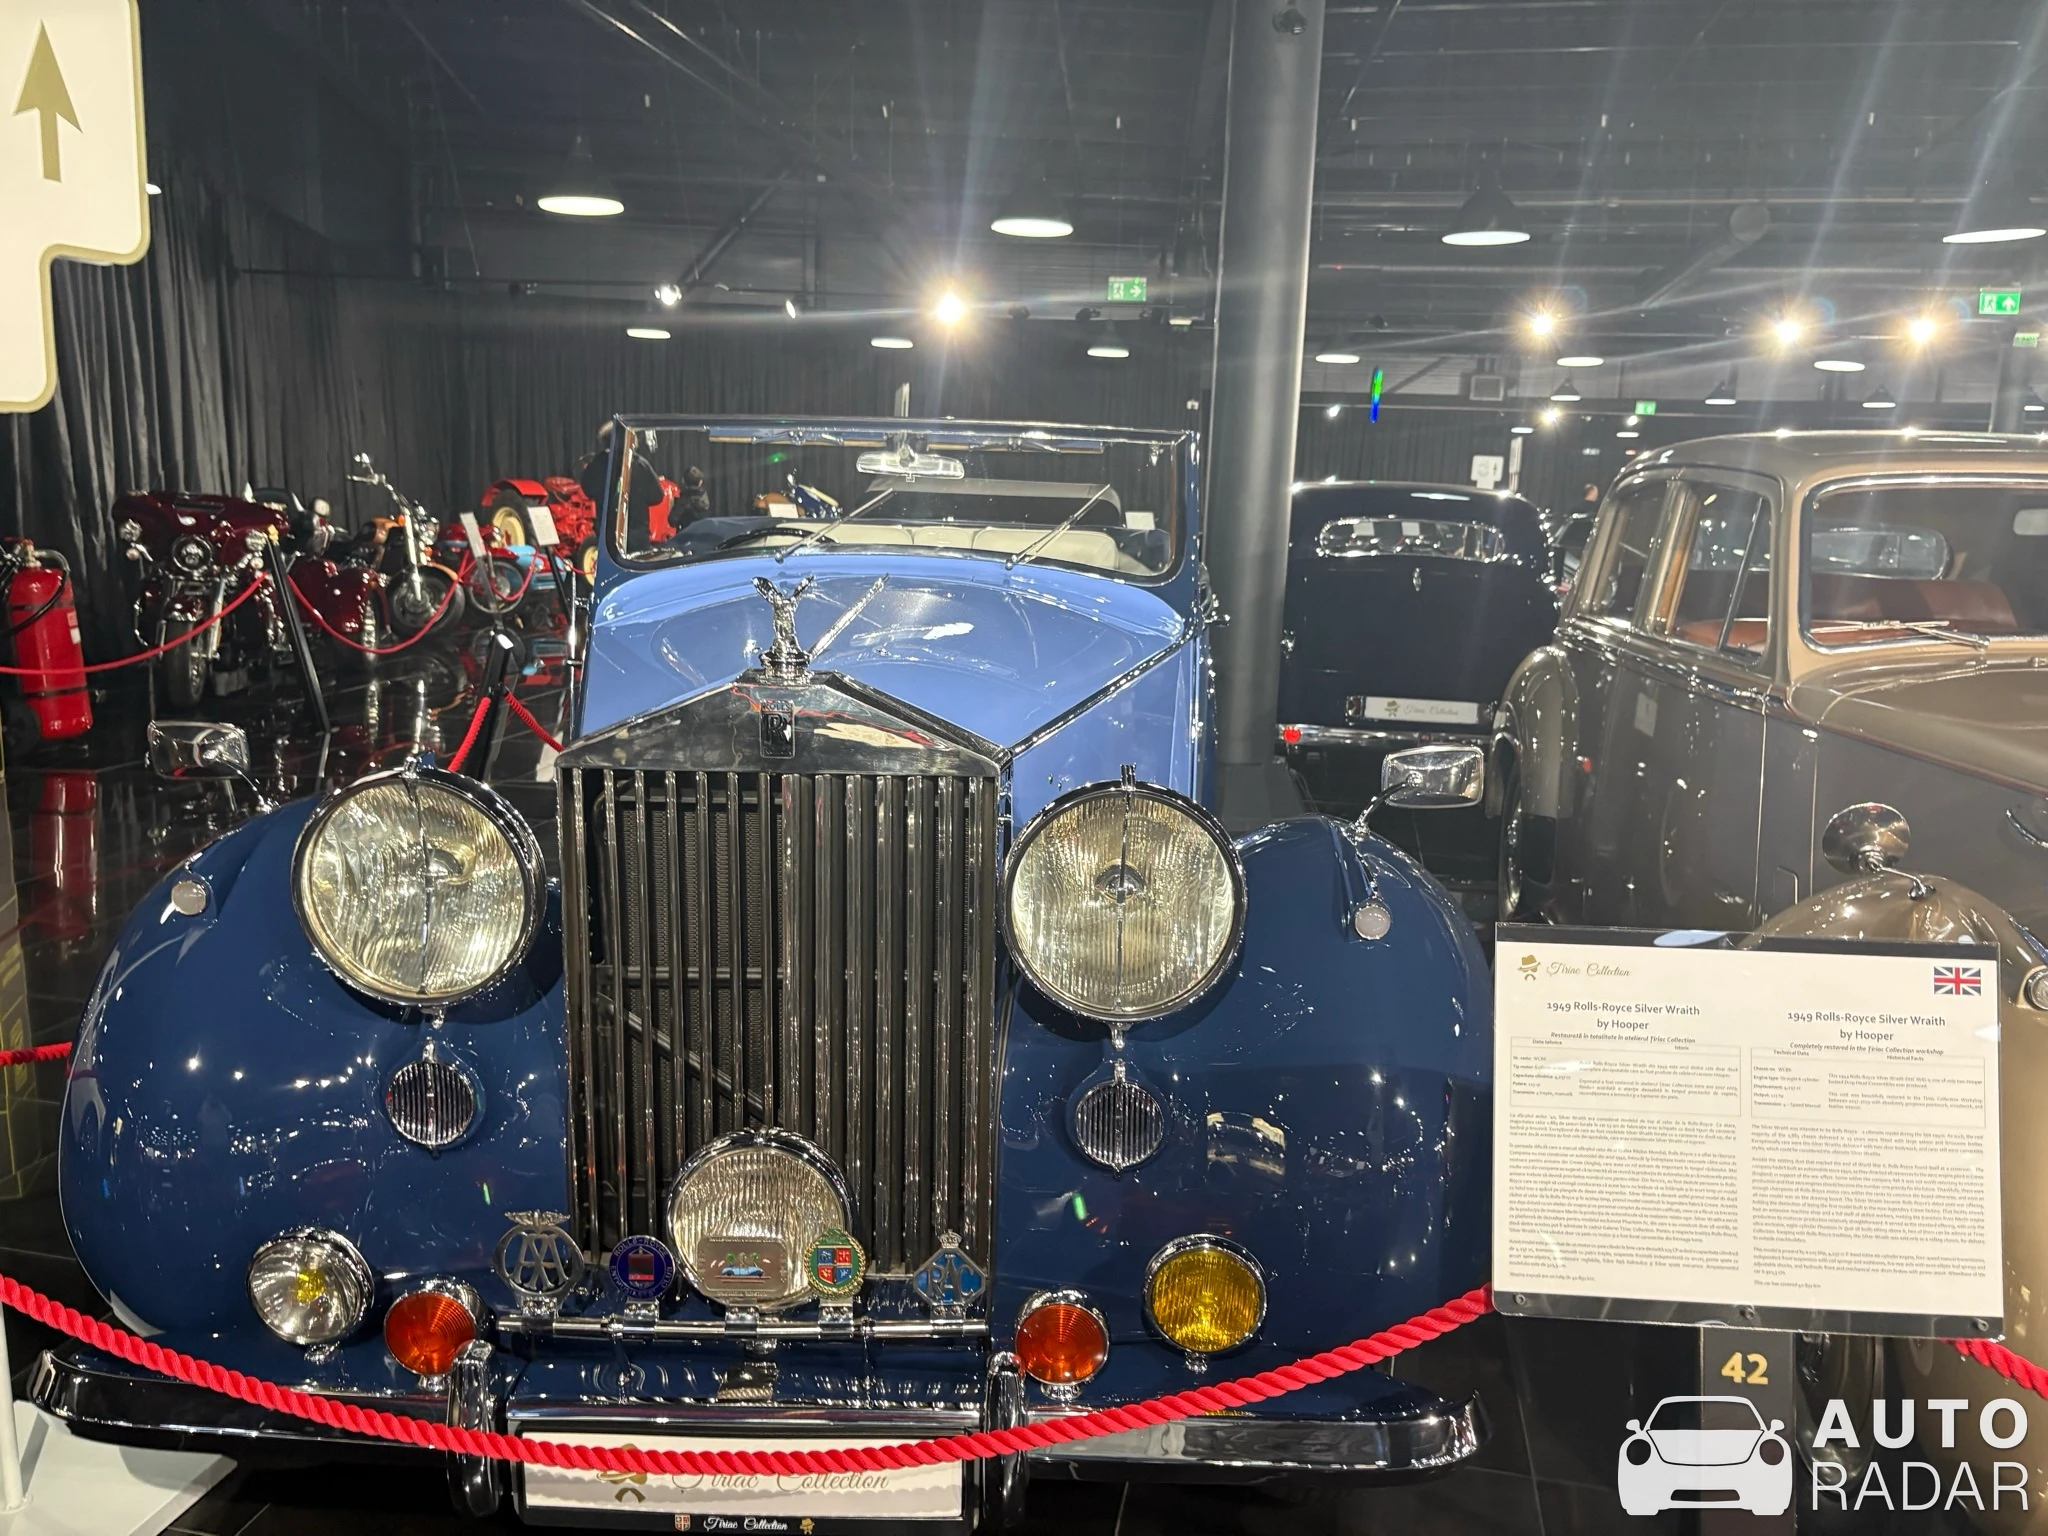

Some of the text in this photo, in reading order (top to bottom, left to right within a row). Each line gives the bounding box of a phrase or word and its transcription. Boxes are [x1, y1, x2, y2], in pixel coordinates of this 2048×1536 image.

[1586, 962, 1631, 977] Collection
[1547, 1001, 1700, 1016] 1949 Rolls-Royce Silver Wraith
[1597, 1018, 1650, 1032] by Hooper
[1787, 1011, 1946, 1027] 1949 Rolls-Royce Silver Wraith
[1667, 1036, 1696, 1044] Collection
[1840, 1029, 1895, 1042] by Hooper
[1789, 1042, 1823, 1052] Completely
[1824, 1043, 1849, 1051] restored
[1885, 1045, 1914, 1054] Collection
[1915, 1047, 1945, 1057] workshop
[508, 1231, 569, 1290] AA
[923, 1254, 978, 1304] RAC
[1721, 1352, 1769, 1385] 42
[743, 1516, 789, 1531] Collection
